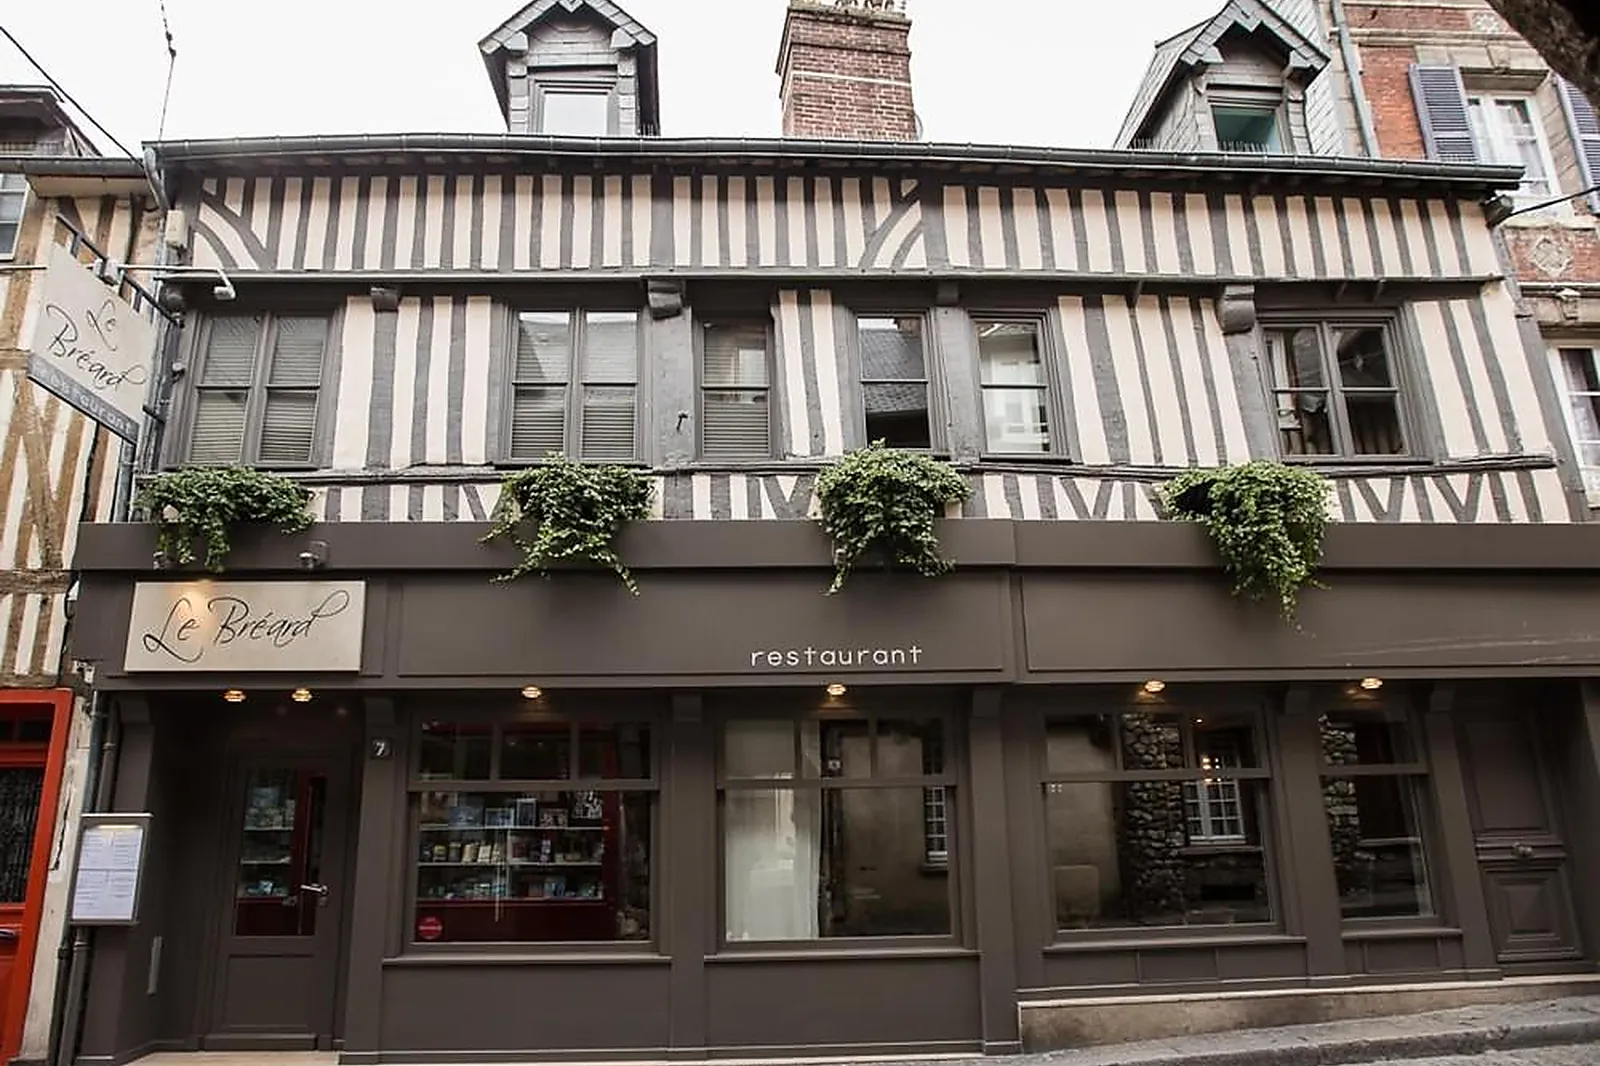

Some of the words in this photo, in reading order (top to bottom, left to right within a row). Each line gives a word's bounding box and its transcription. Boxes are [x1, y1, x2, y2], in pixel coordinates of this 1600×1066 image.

[86, 298, 119, 352] Le
[142, 597, 204, 663] Le
[207, 589, 351, 648] Bréard
[750, 644, 923, 667] restaurant
[375, 741, 386, 756] 7
